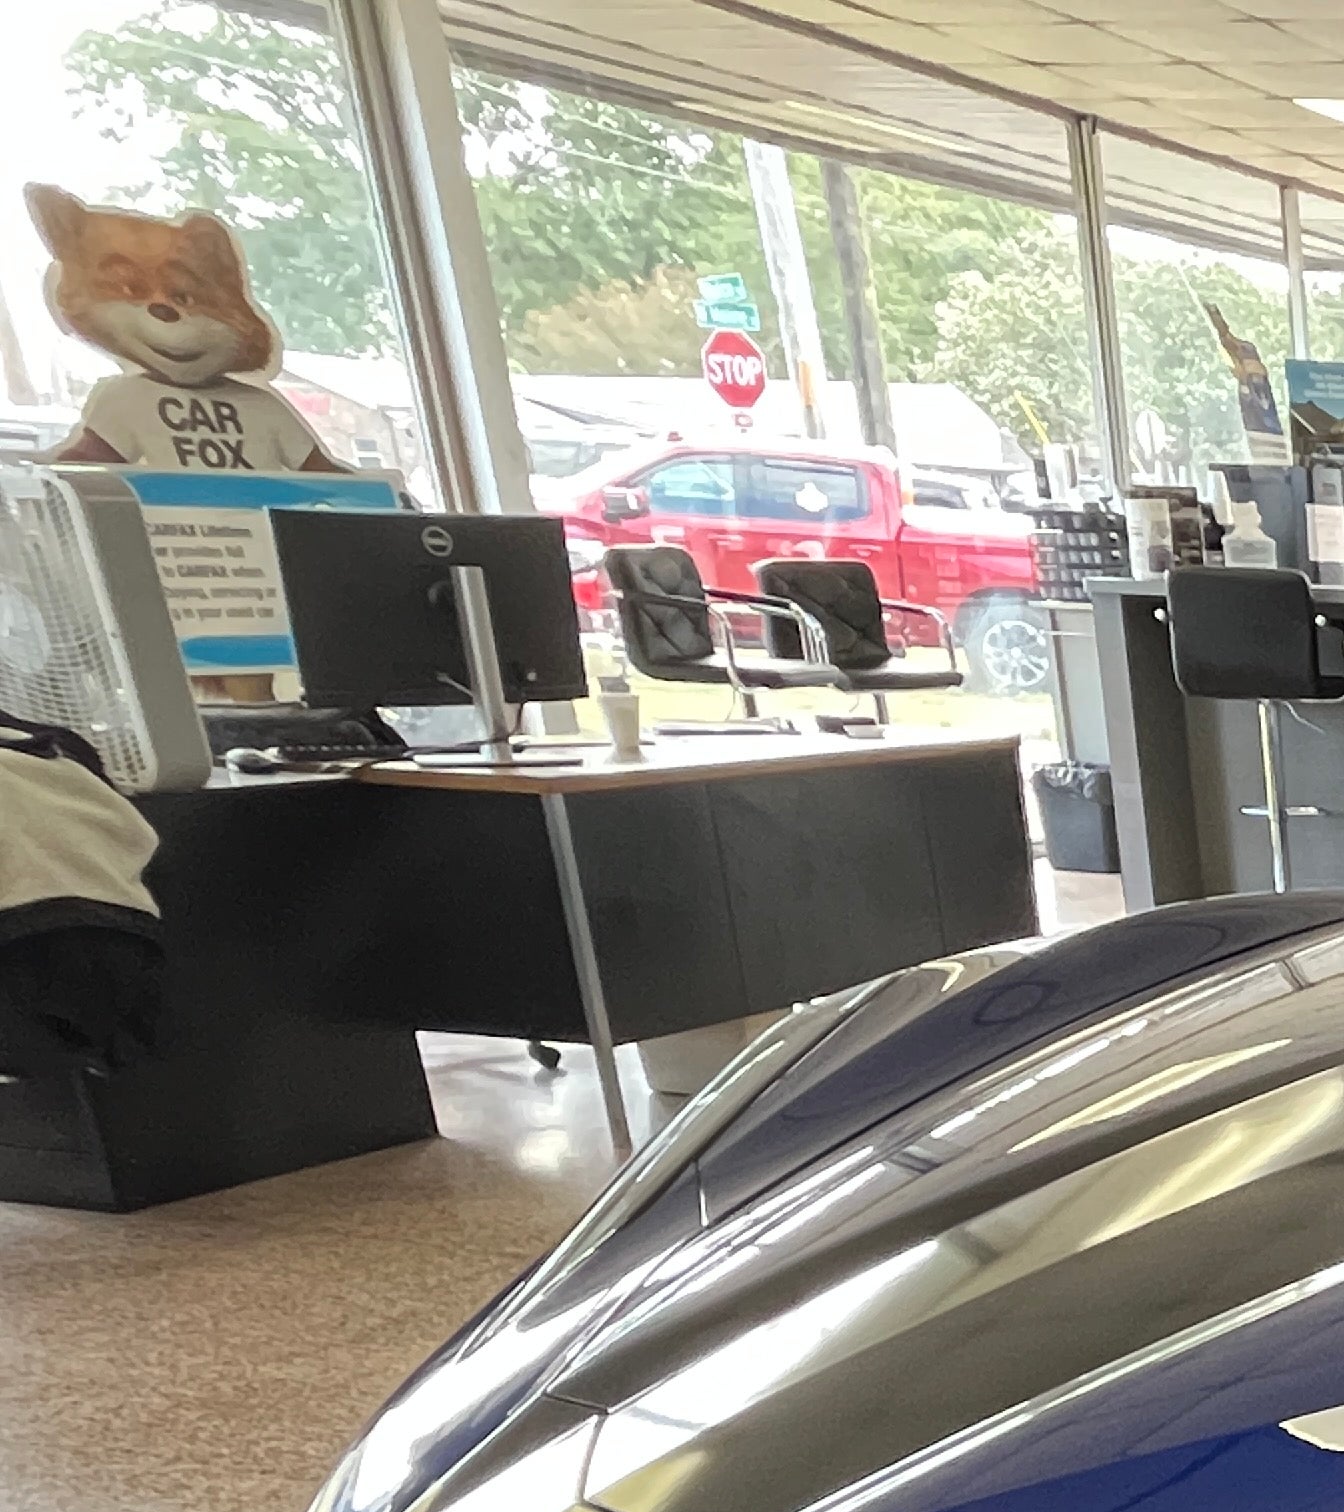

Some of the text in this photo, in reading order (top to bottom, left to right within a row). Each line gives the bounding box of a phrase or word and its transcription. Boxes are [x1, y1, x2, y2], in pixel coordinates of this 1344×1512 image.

[707, 353, 763, 387] STOP
[158, 396, 244, 434] CAR
[171, 436, 255, 470] FOX
